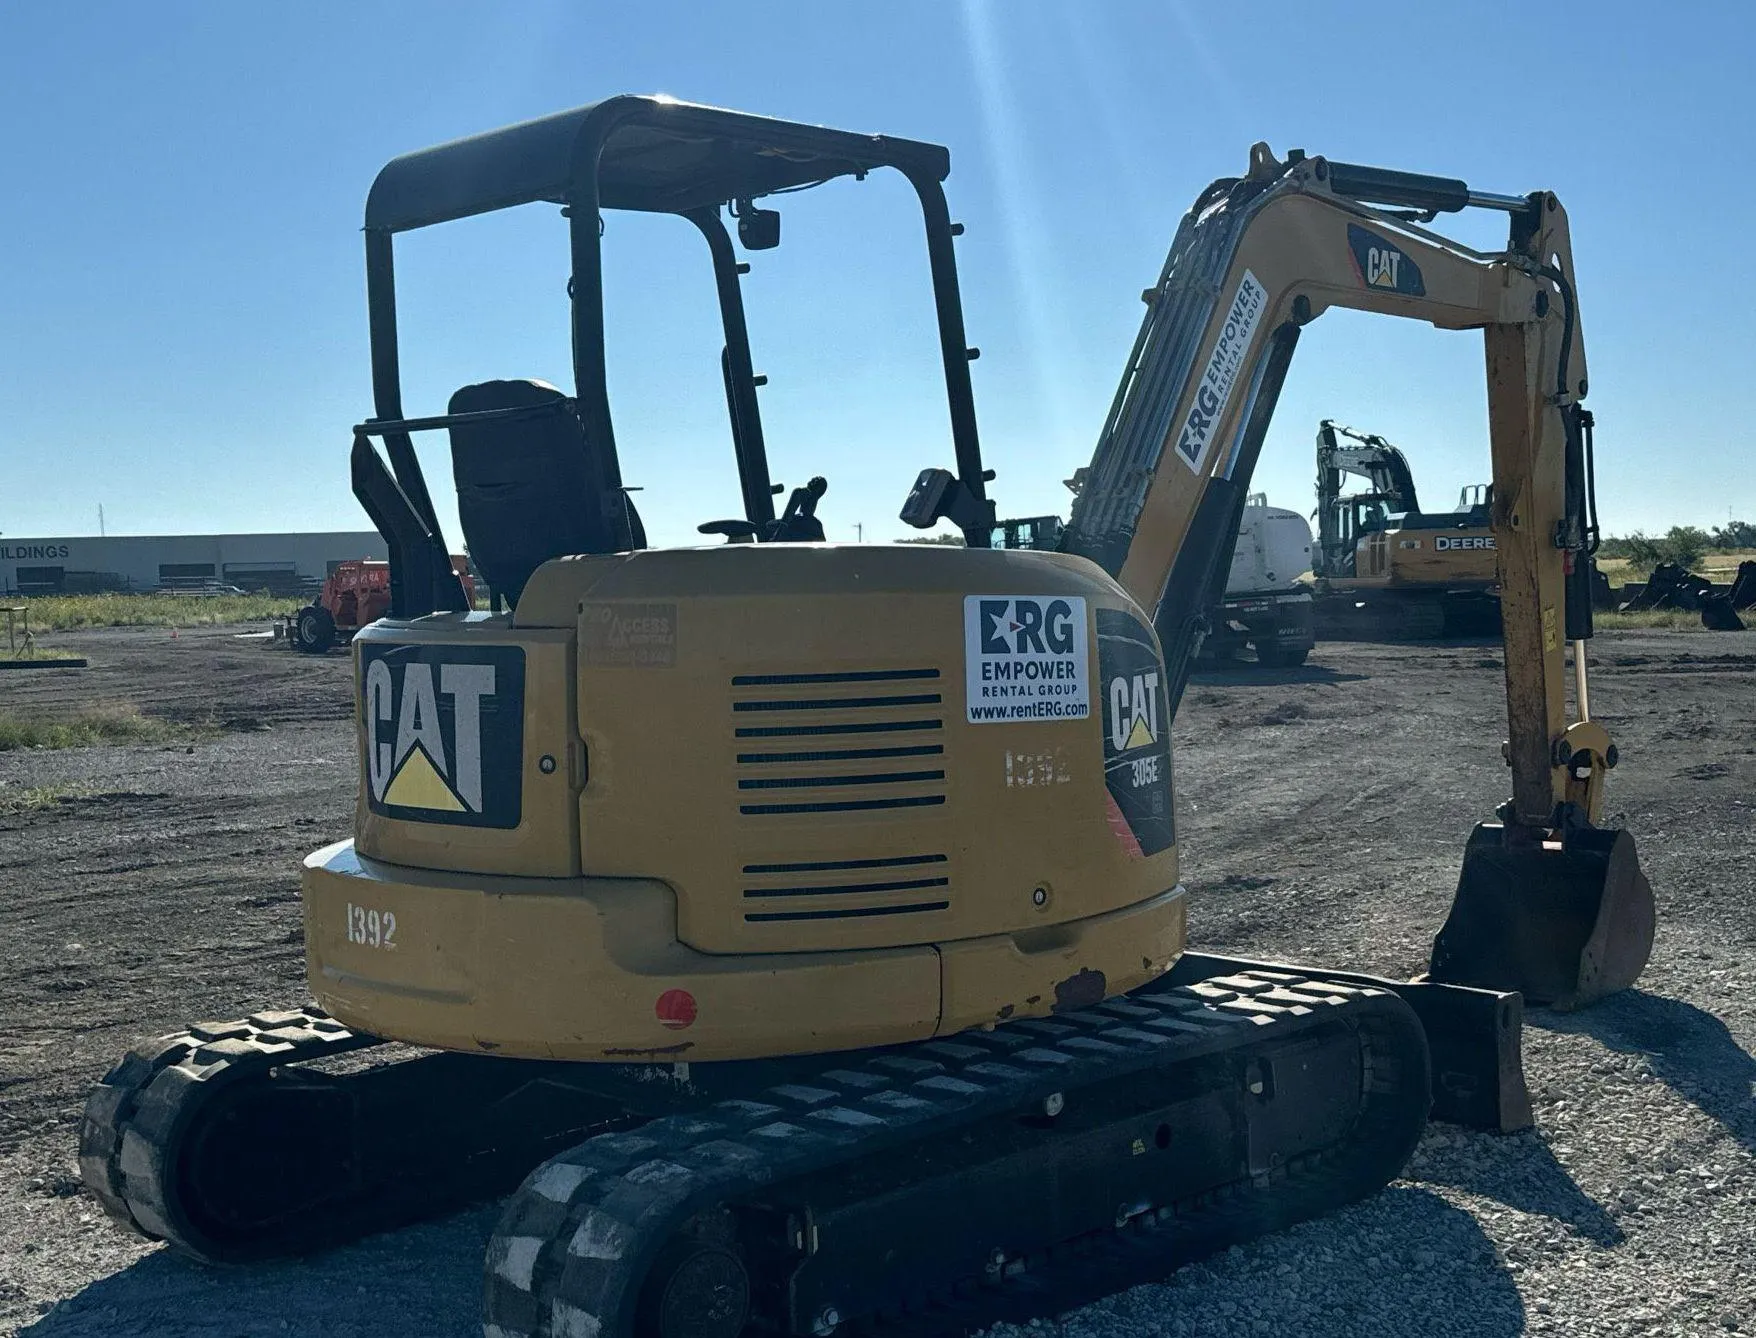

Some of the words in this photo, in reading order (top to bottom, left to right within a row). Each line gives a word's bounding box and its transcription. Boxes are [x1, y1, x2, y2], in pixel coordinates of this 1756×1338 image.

[1367, 247, 1401, 288] CAT
[1207, 279, 1255, 386] EMPOWER
[1218, 342, 1242, 395] RENTAL
[1240, 290, 1261, 338] GROUP
[1179, 385, 1220, 463] ERG
[1435, 536, 1496, 551] DEERE
[980, 600, 1074, 654] ERG
[981, 660, 1076, 680] EMPOWER
[982, 685, 1033, 698] RENTAL
[1038, 684, 1077, 697] GROUP
[970, 701, 1088, 720] www.rentERG.com
[1110, 672, 1159, 751] CAT
[366, 658, 497, 813] CAT
[1131, 755, 1159, 788] 305E
[346, 902, 397, 950] 1392
